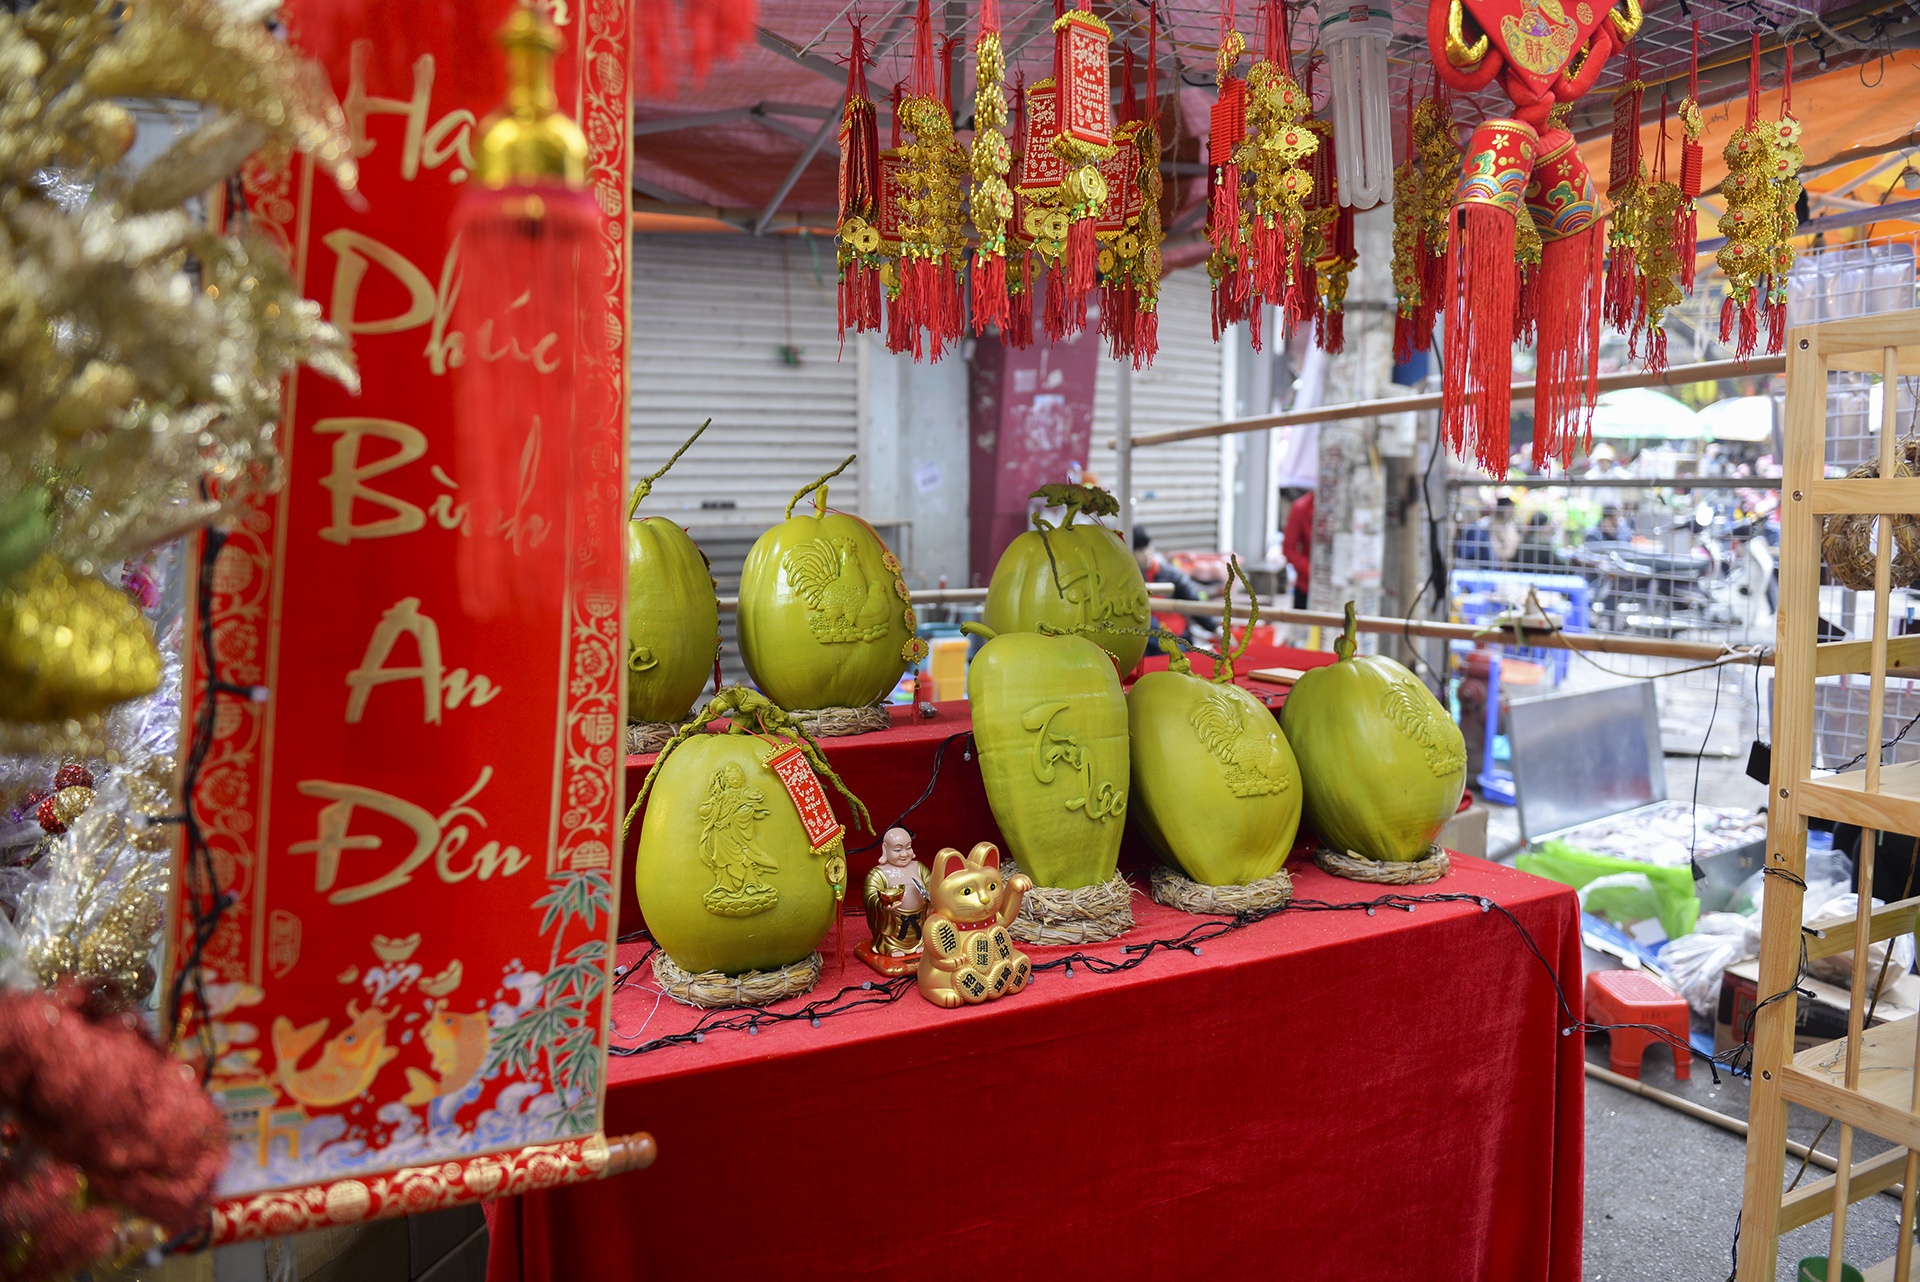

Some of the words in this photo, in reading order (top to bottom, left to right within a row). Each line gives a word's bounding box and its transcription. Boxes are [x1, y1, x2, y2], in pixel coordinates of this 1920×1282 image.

[1082, 70, 1096, 82] An
[1076, 76, 1103, 94] Khang
[1076, 86, 1103, 101] Thịnh
[1076, 95, 1104, 112] Vượng
[1040, 128, 1054, 136] An
[1031, 144, 1048, 153] Thị
[1030, 151, 1055, 160] Vượn
[1107, 191, 1120, 199] hư
[1061, 546, 1150, 630] Phúc
[344, 597, 502, 726] An
[798, 786, 815, 797] Vạn
[804, 793, 815, 804] Sự
[804, 798, 821, 812] Như
[288, 765, 532, 903] Đến
